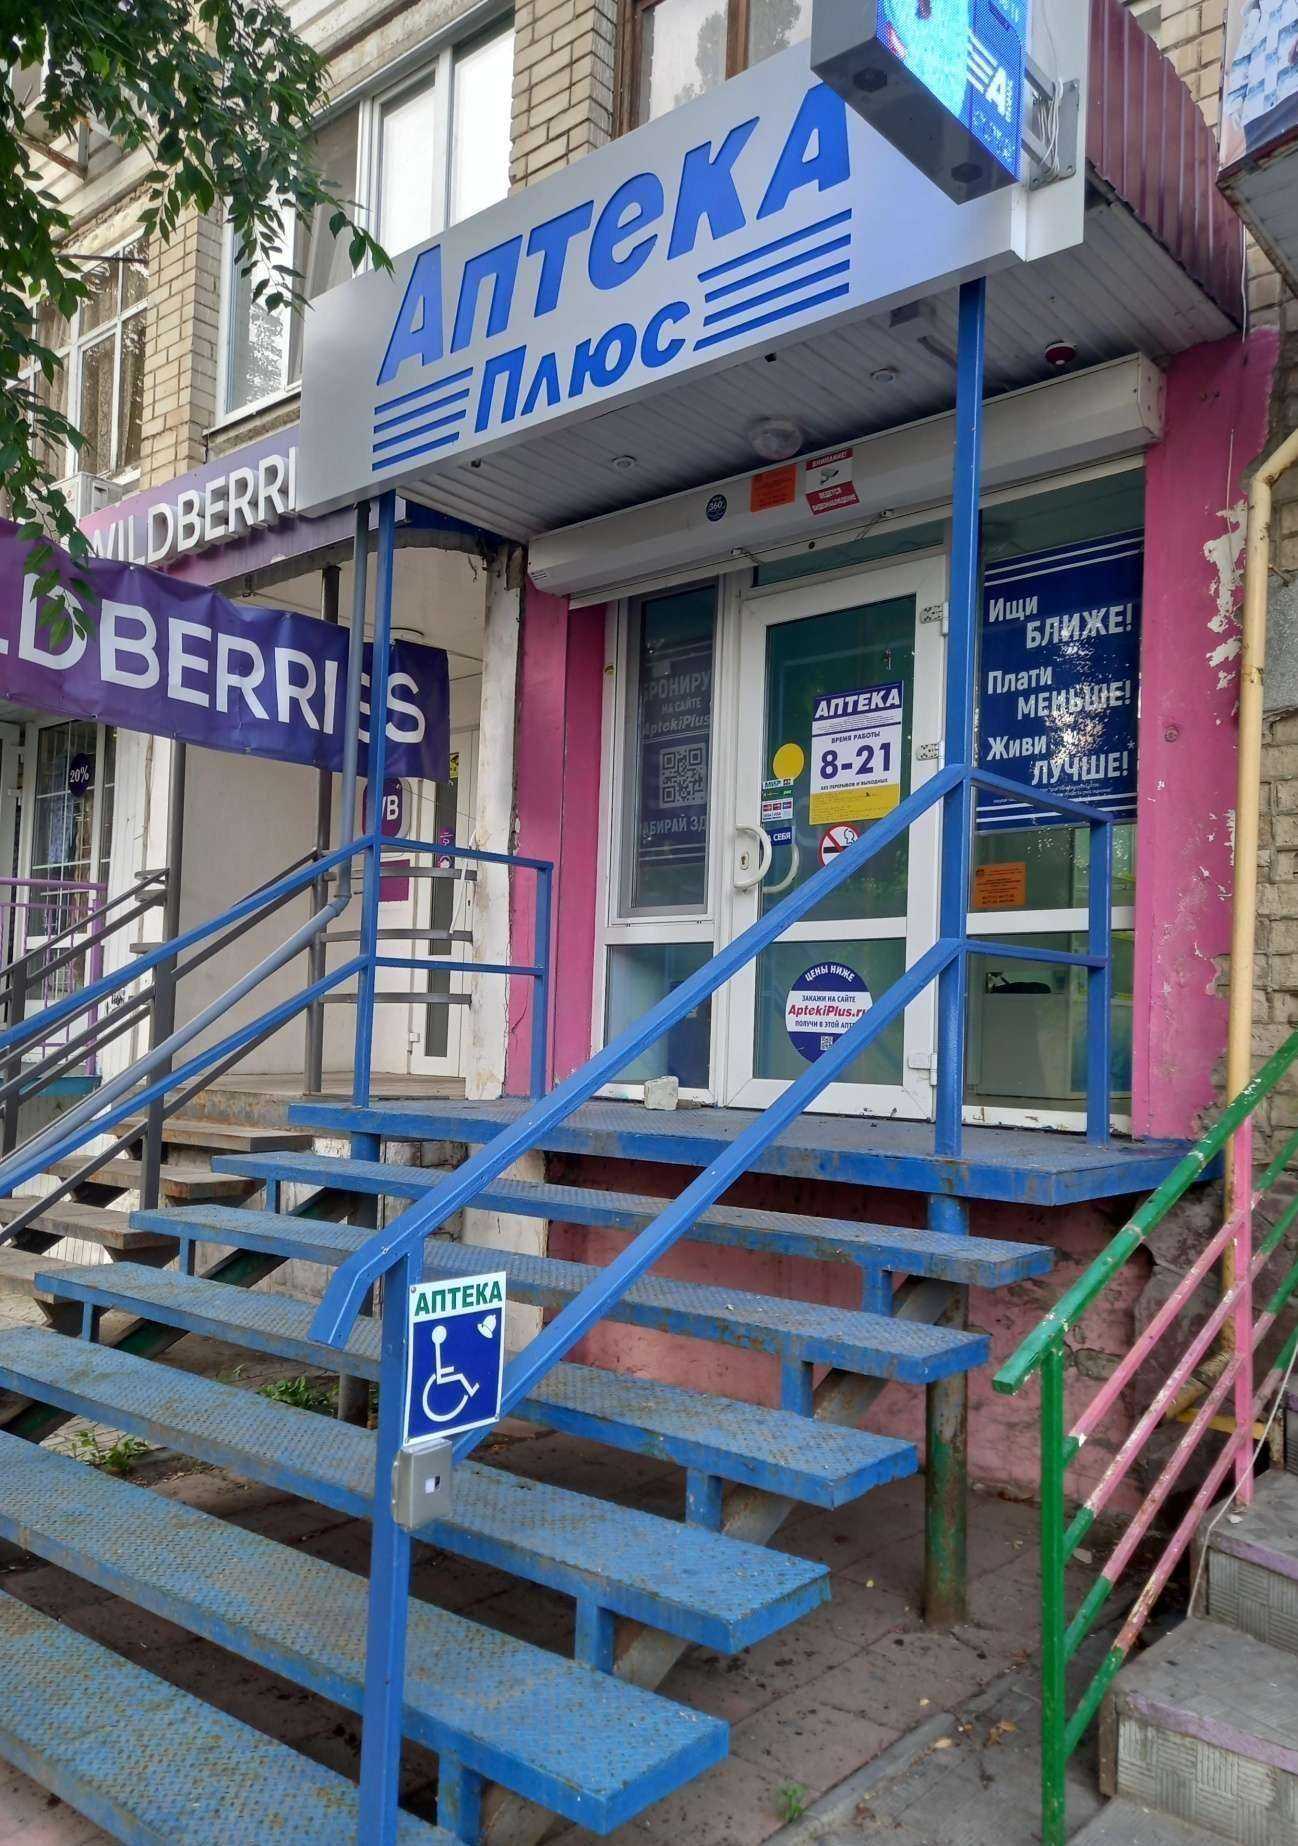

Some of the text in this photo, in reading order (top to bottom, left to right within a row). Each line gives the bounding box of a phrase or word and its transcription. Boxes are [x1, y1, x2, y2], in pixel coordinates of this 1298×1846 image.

[988, 596, 1038, 623] Ищи
[1026, 603, 1133, 649] БЛИЖЕ!
[987, 666, 1053, 695] Плати
[814, 687, 900, 719] АПТЕКА
[820, 742, 891, 780] 8-21
[986, 735, 1047, 761] Живи
[805, 964, 856, 983] ЦЕНЫ НИЖЕ
[414, 1280, 503, 1317] АПТЕКА
